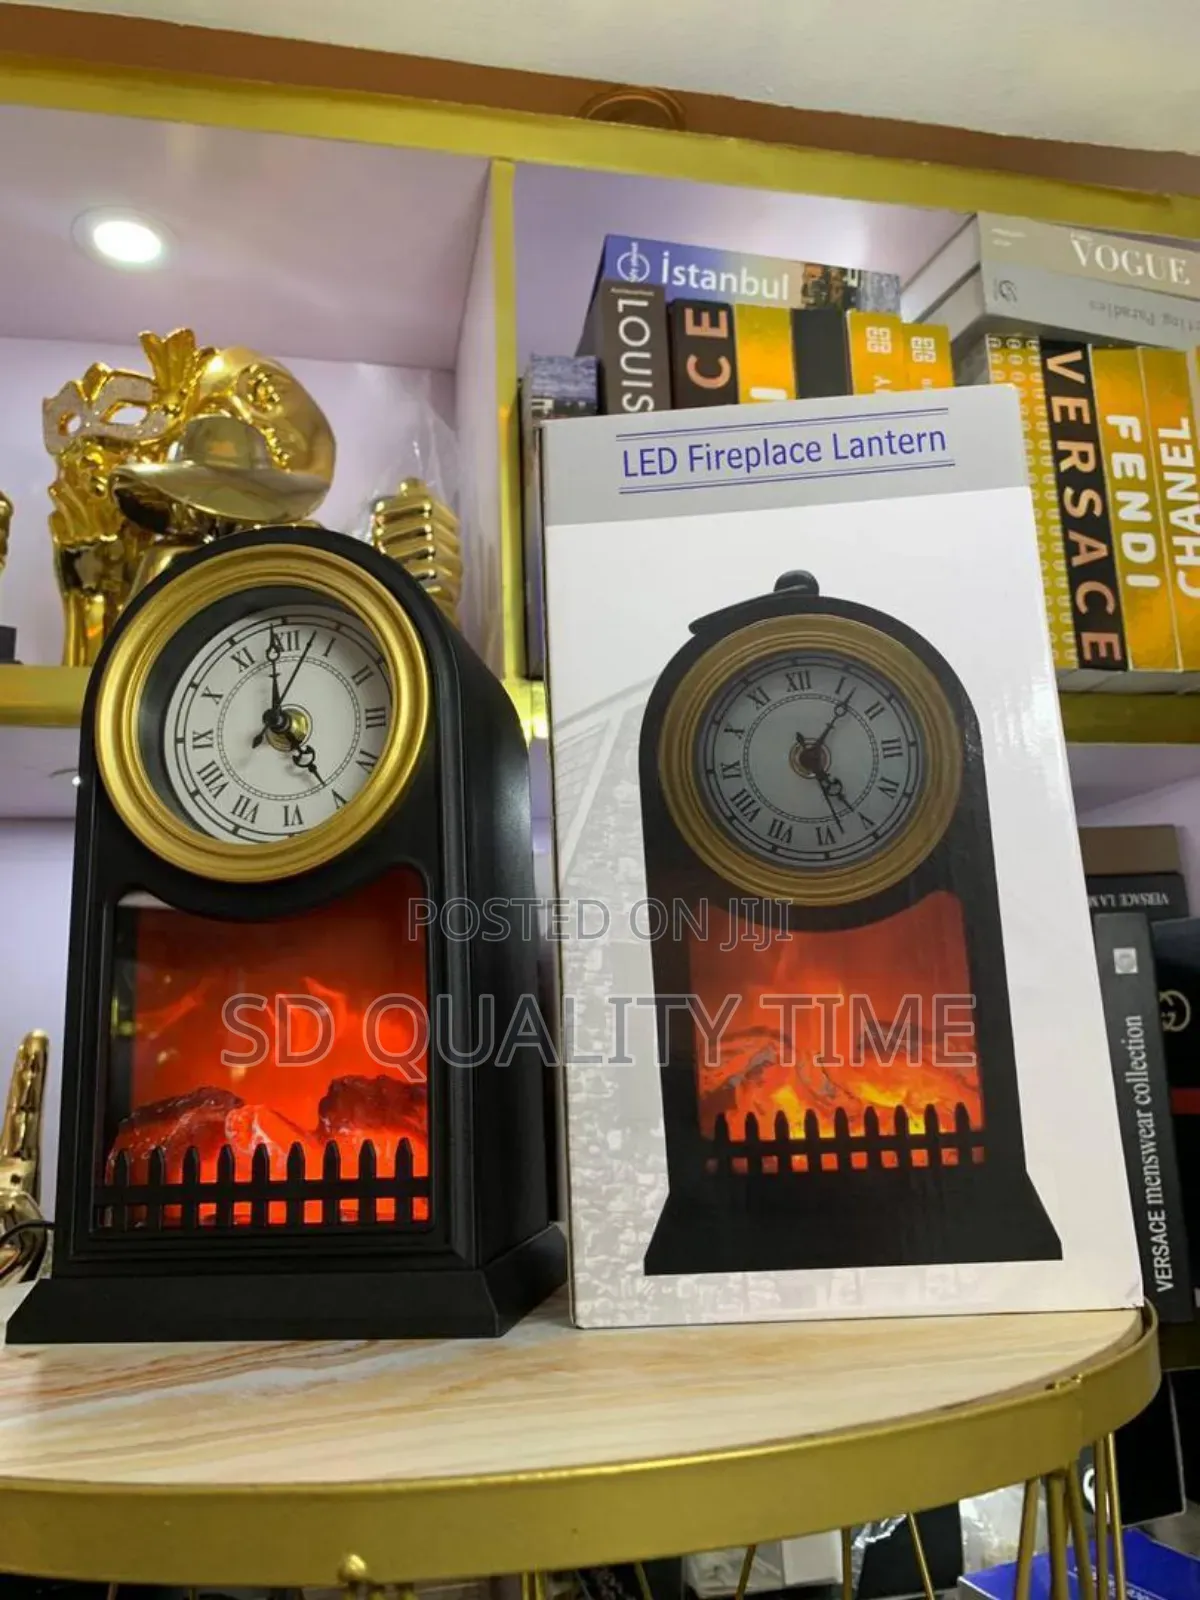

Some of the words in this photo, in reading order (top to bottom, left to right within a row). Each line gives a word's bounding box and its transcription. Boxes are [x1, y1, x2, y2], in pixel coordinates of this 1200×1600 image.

[660, 251, 789, 301] İstanbul
[1071, 239, 1191, 286] VOGUE
[617, 297, 655, 412] LOUIS
[623, 447, 678, 478] LED
[688, 438, 823, 473] Fireplace
[832, 429, 947, 461] Lantern
[1046, 350, 1122, 662] VERSACE
[1105, 414, 1161, 588] FENDI
[1157, 416, 1200, 600] CHANEL
[1120, 1014, 1152, 1106] collection
[1136, 1110, 1165, 1205] menswear
[1147, 1210, 1175, 1293] VERSACE
